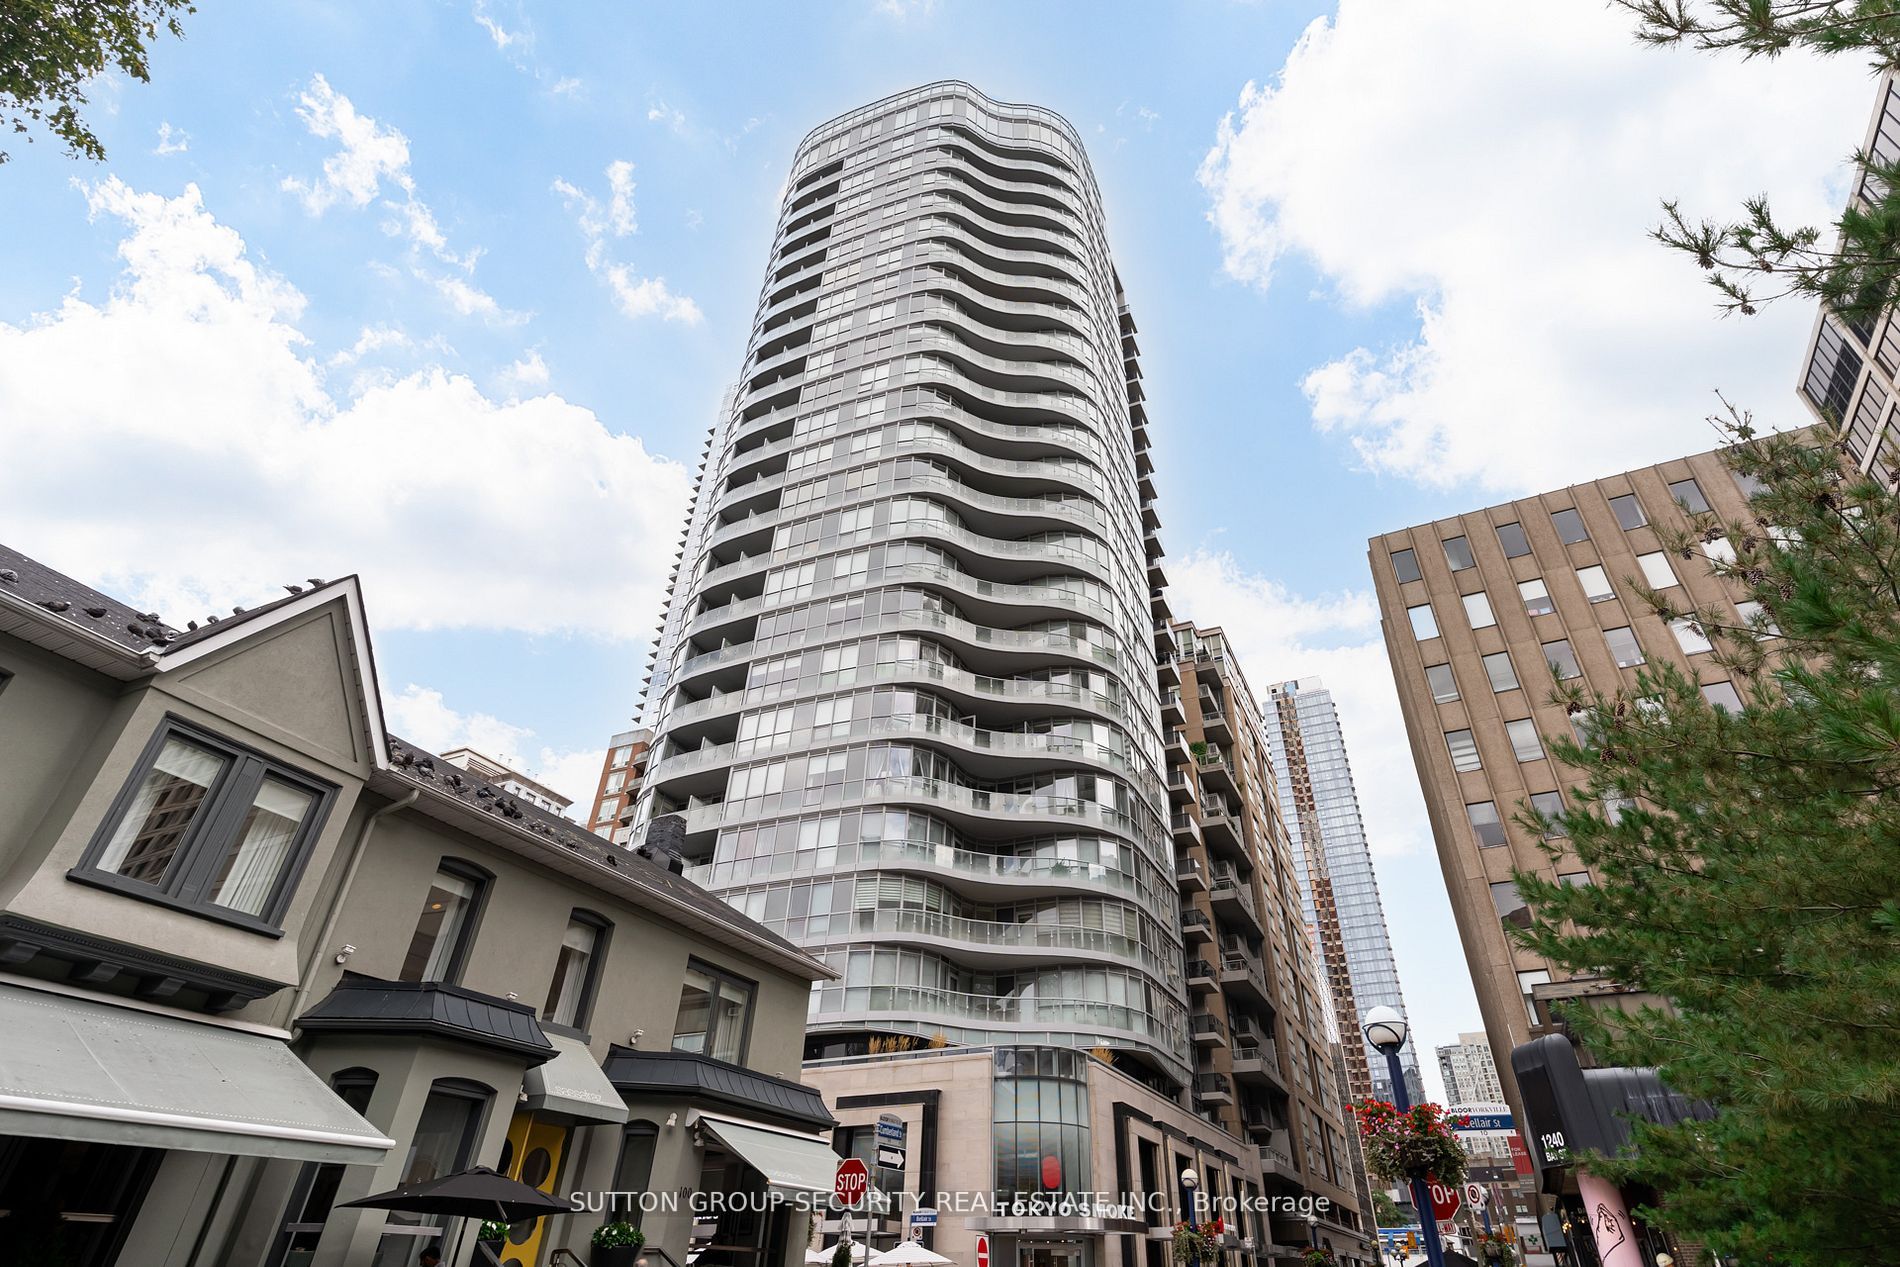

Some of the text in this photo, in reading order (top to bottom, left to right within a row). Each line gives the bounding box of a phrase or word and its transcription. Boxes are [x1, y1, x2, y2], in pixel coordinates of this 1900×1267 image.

[1541, 1131, 1565, 1150] 1240
[837, 1173, 866, 1191] STOP
[679, 1186, 693, 1199] 100
[996, 1201, 1137, 1220] TOKYO SMOKE
